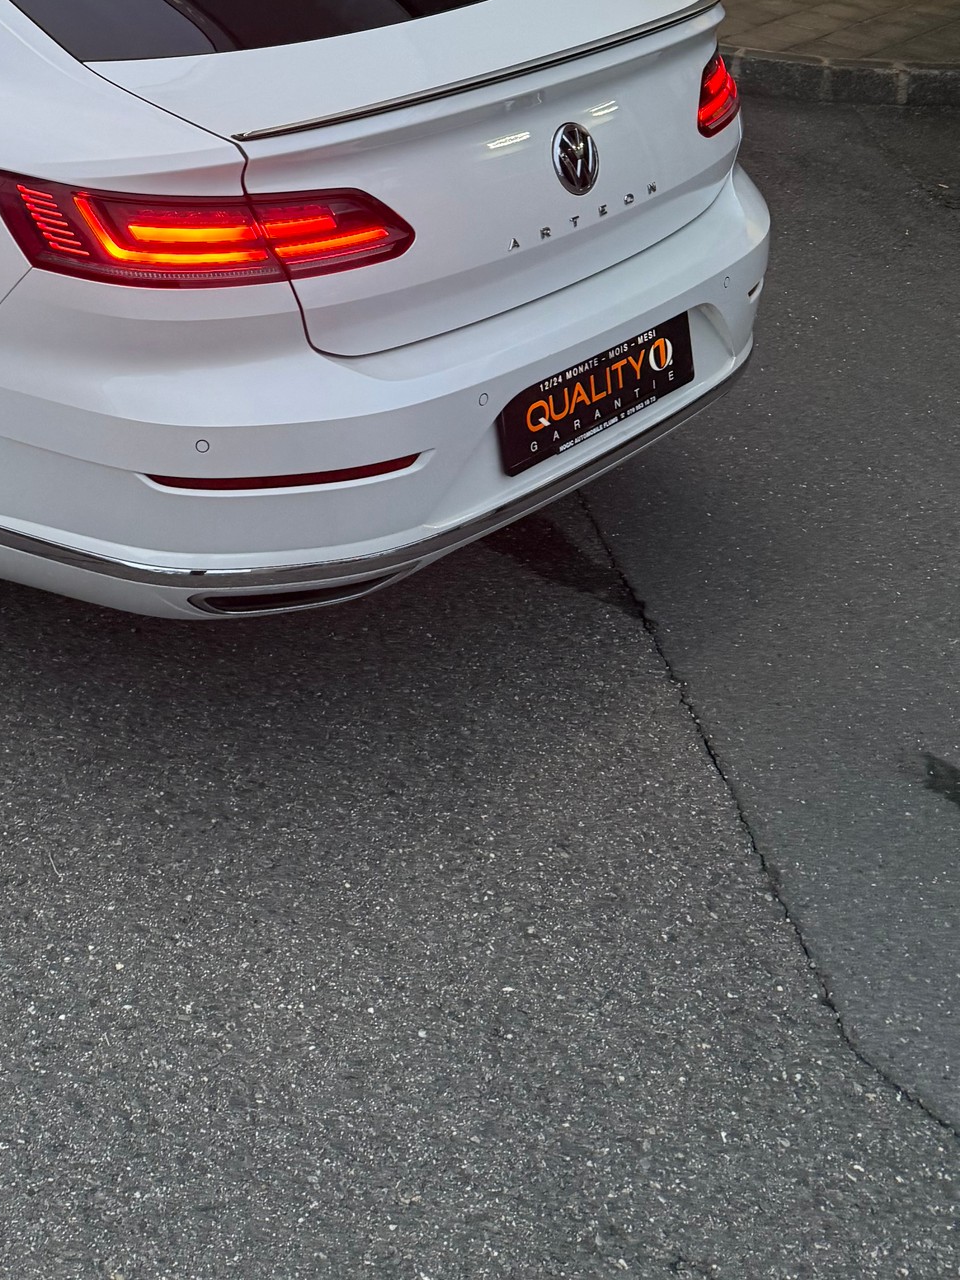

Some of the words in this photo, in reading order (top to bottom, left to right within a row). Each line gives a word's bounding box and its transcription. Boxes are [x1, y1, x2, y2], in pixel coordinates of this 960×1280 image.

[508, 181, 658, 252] ARTEON
[526, 349, 646, 433] QUALITY
[539, 376, 563, 392] 12/24
[565, 357, 599, 380] MONATE
[608, 343, 629, 360] MOIS
[637, 329, 657, 345] MESI
[530, 370, 675, 453] GARANTIE
